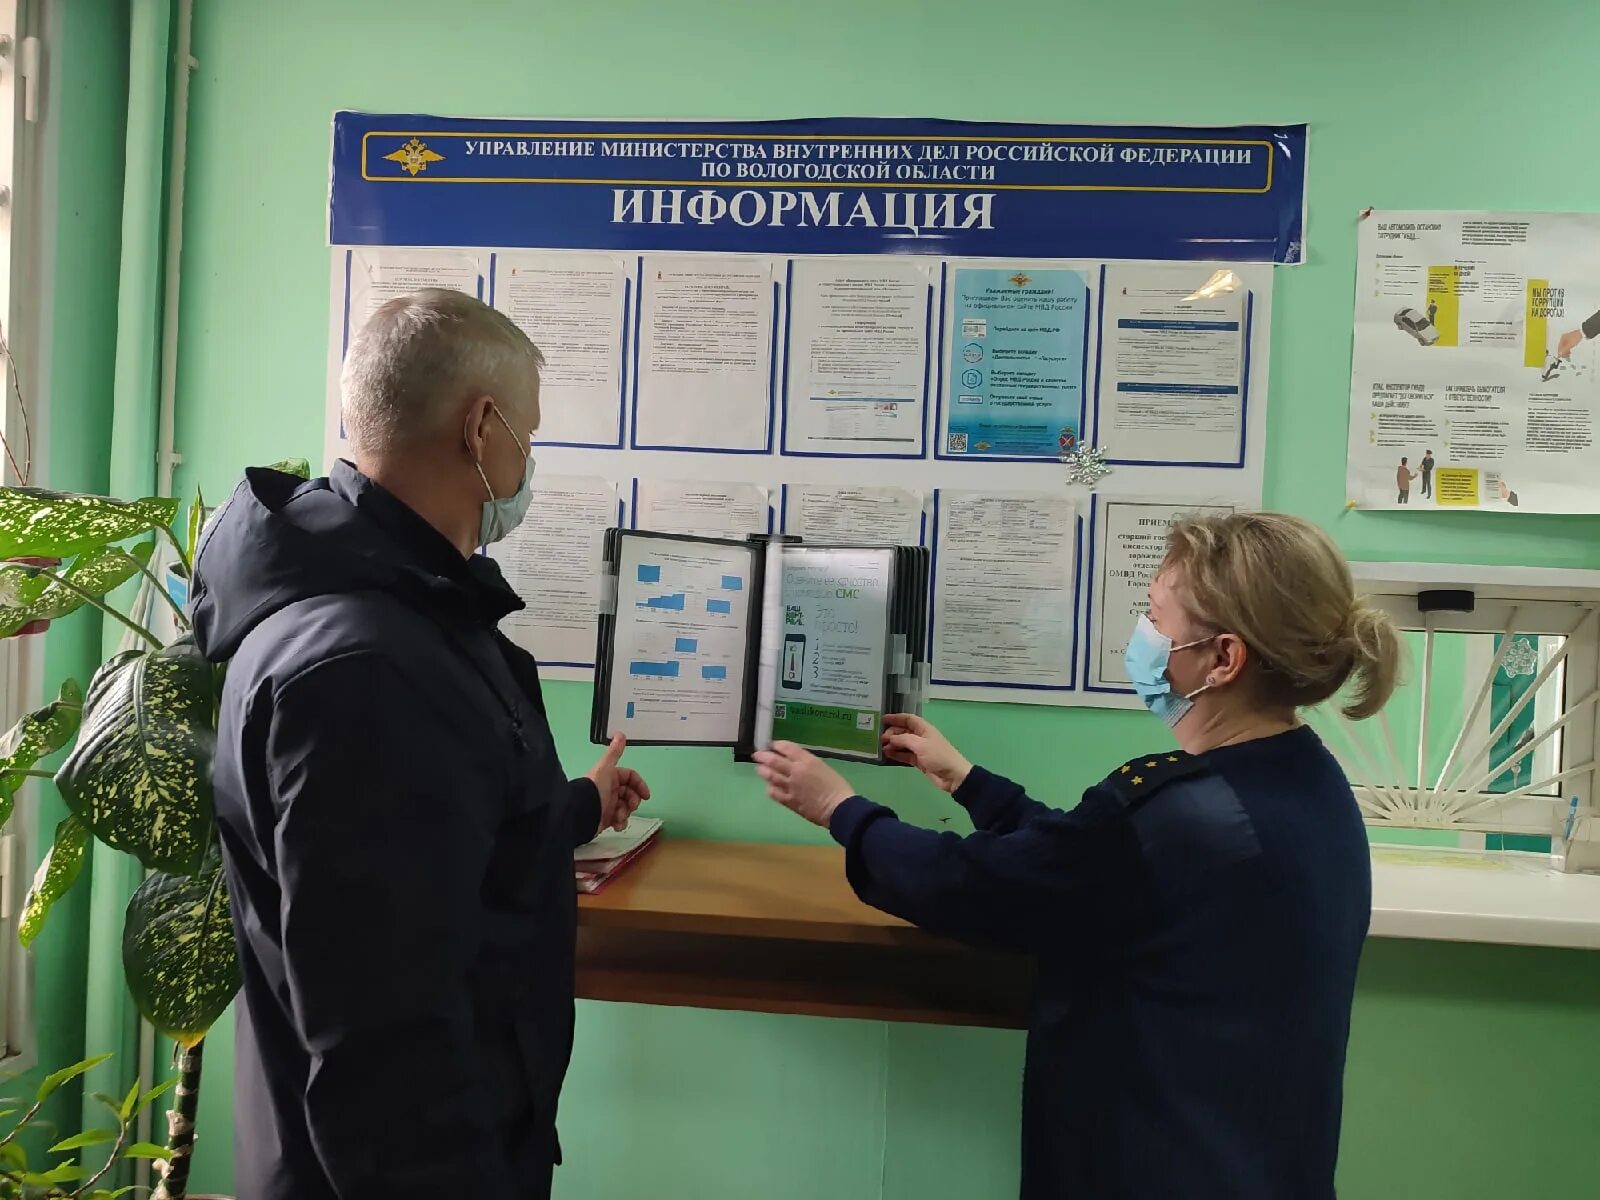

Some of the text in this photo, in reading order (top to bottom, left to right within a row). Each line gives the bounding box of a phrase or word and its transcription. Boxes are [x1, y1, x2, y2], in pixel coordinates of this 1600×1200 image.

[465, 141, 1251, 166] УПРАВЛЕНИЕ МИНИСТЕРСТВА ВНУТРЕННИХ ДЕЛ РОССИЙСКОЙ ФЕДЕРАЦИИ
[701, 161, 995, 182] ПО ВОЛОГОДСКОЙ ОБЛАСТИ
[610, 189, 997, 237] ИНФОРМАЦИЯ
